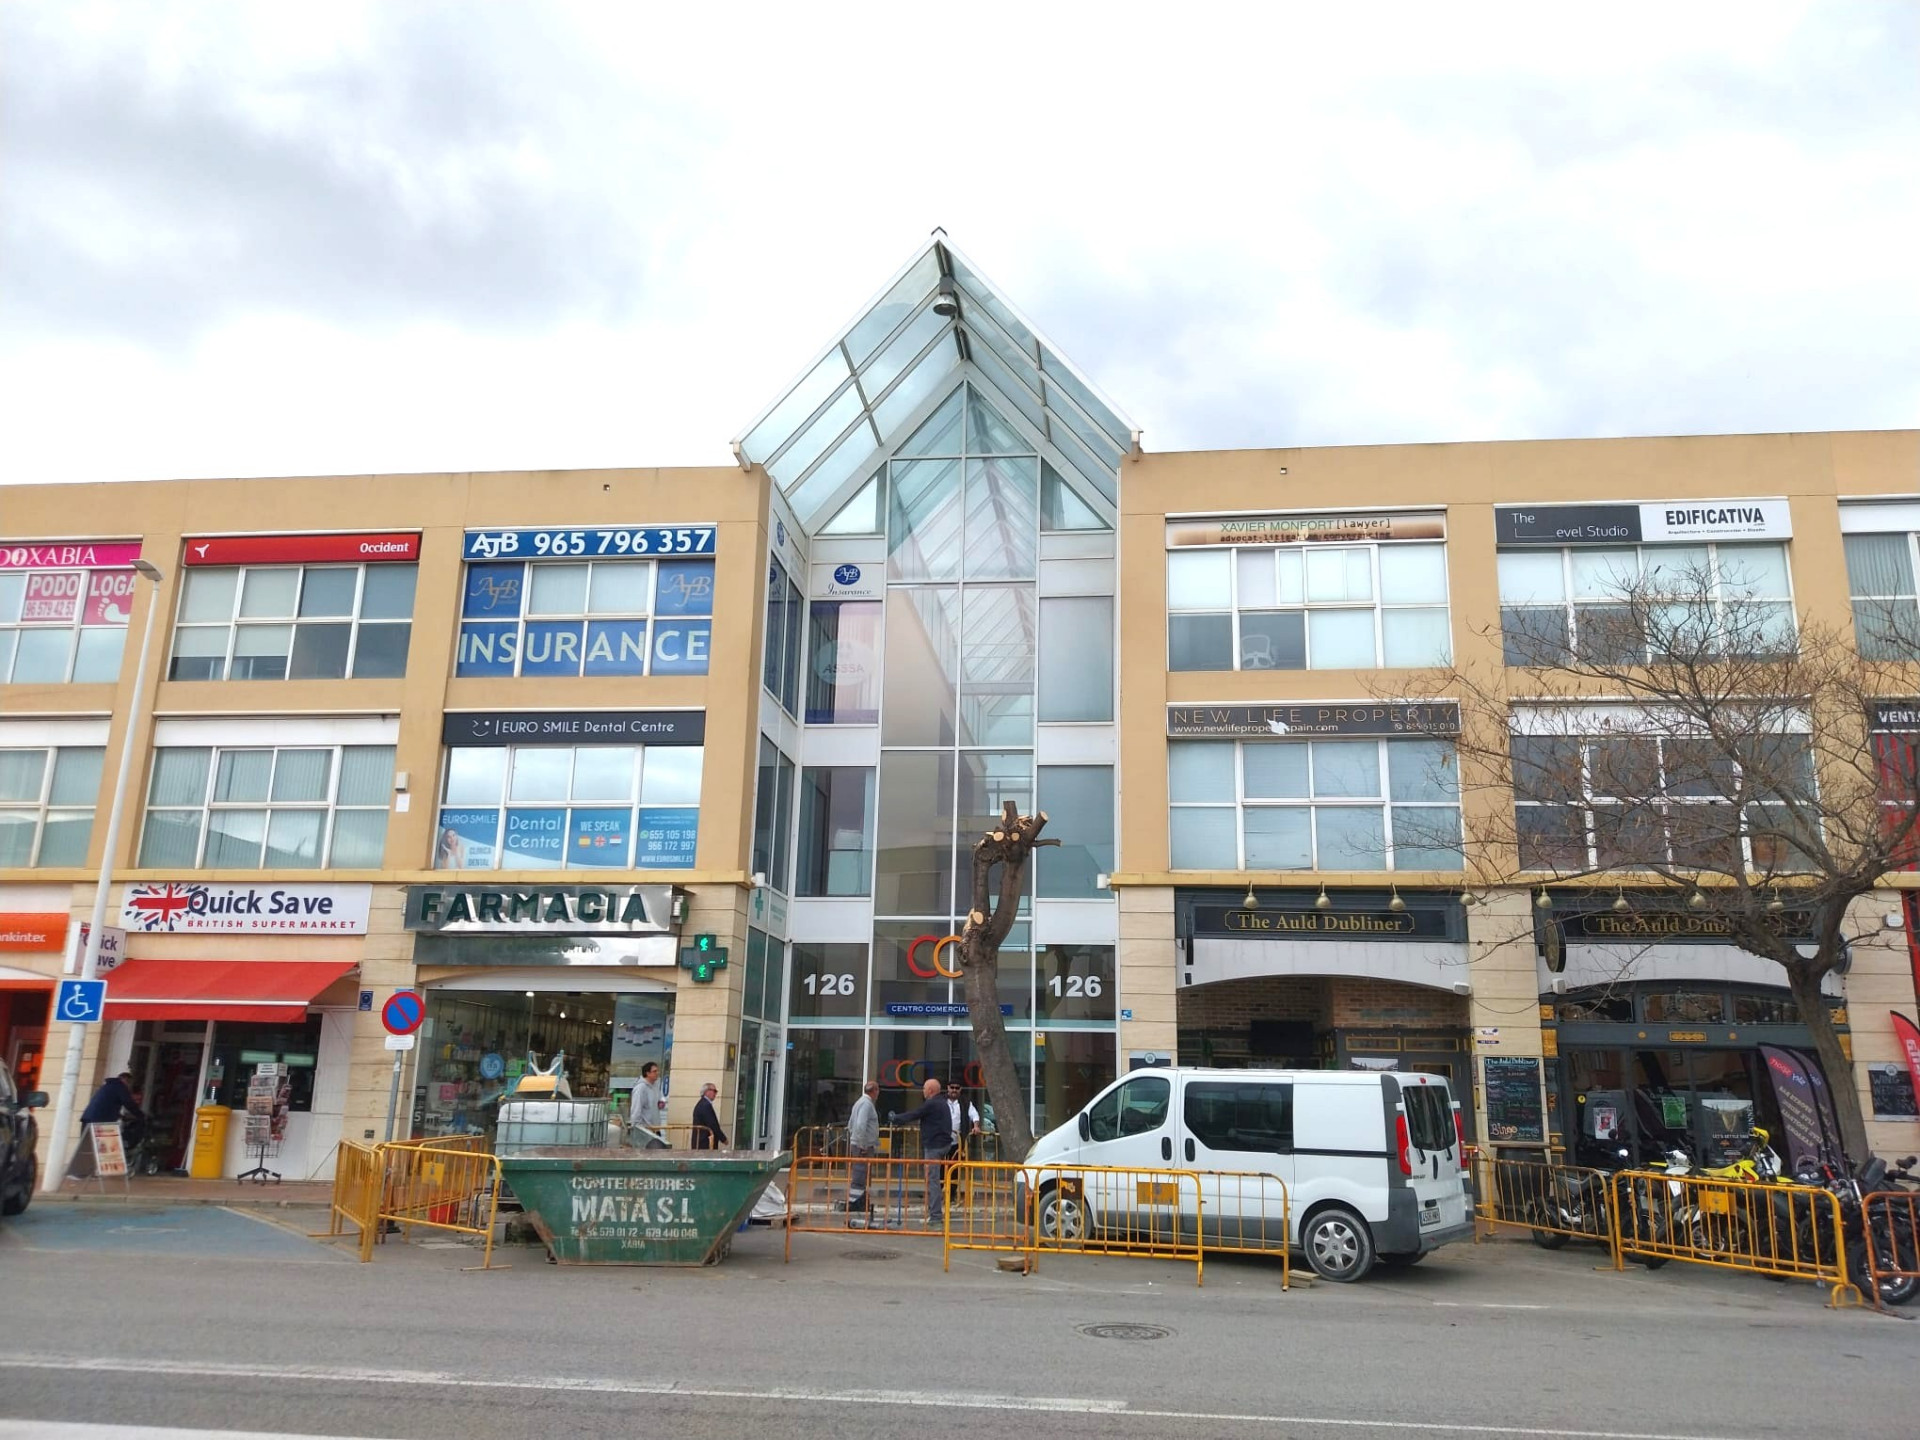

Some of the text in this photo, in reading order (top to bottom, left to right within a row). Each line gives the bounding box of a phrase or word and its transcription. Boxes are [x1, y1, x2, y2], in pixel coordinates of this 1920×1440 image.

[1511, 513, 1535, 524] The
[1665, 508, 1765, 525] EDIFICATIVA
[1221, 521, 1266, 532] XAVIER
[1270, 520, 1334, 531] MONFORT
[1586, 525, 1629, 537] Studio
[360, 541, 409, 554] Occident
[470, 529, 712, 557] AJB 965 796 357
[29, 575, 79, 597] PODO
[459, 630, 709, 663] INSURANCE
[1174, 707, 1454, 723] NEW LIFE PROPERTY
[1878, 711, 1920, 723] VENT
[502, 720, 675, 733] EURO SMILE Dental Centre
[1174, 724, 1338, 734] www.newlifepropepain.com
[443, 814, 498, 825] EURO SMILE
[509, 816, 560, 830] Dental
[580, 820, 620, 832] WE SPEAK
[508, 834, 560, 849] Centre
[188, 889, 333, 916] Quick Save
[421, 892, 652, 924] FARMACIA
[187, 920, 356, 929] BRITISH SUPERMARKET
[1237, 914, 1402, 931] The Auld Dubliner
[1596, 917, 1632, 933] The
[1637, 917, 1680, 933] Auld
[803, 973, 855, 996] 126
[1049, 975, 1102, 998] 126
[891, 1005, 970, 1014] CENTRO COMERCIAL
[572, 1176, 696, 1191] CONTENEDORES
[572, 1195, 651, 1223] MATA
